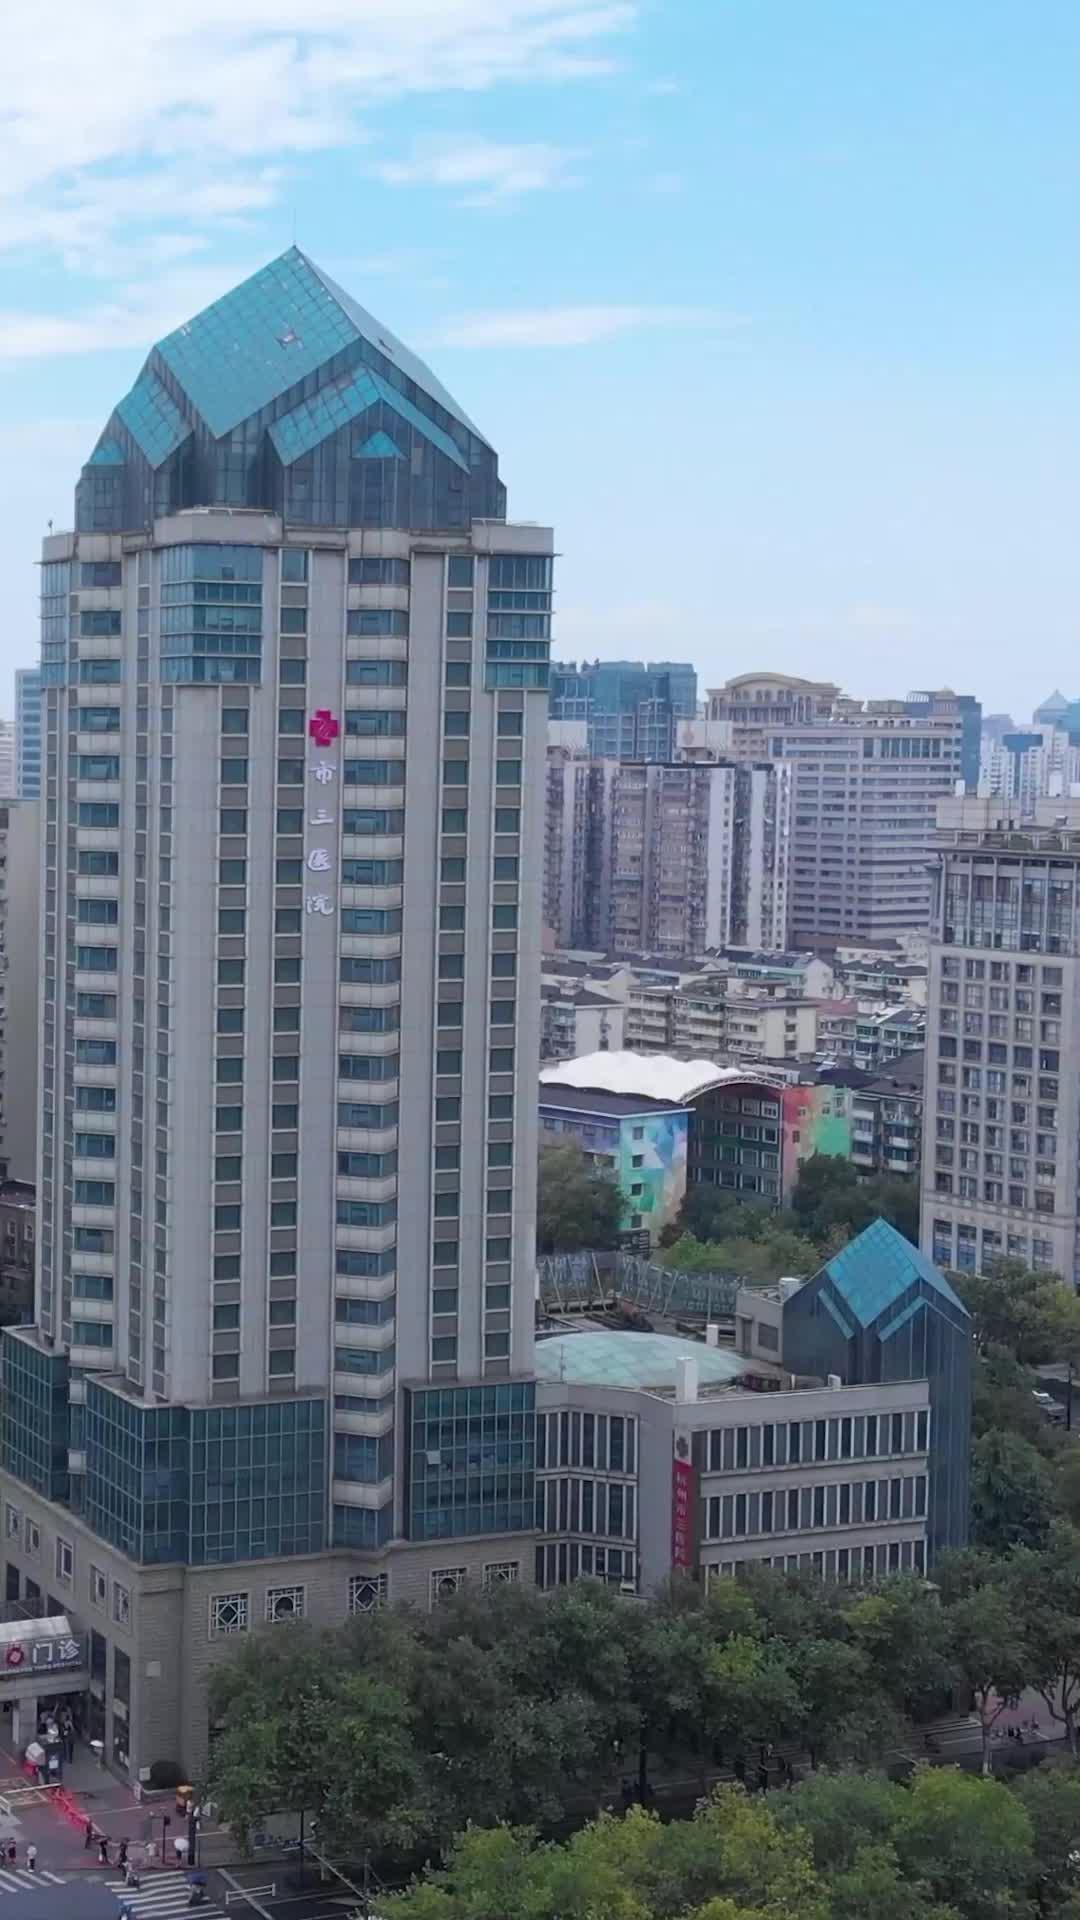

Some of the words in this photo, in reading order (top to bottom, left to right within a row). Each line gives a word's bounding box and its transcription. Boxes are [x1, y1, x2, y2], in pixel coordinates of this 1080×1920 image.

[306, 760, 337, 915] 市三医院
[33, 1639, 80, 1663] 门诊
